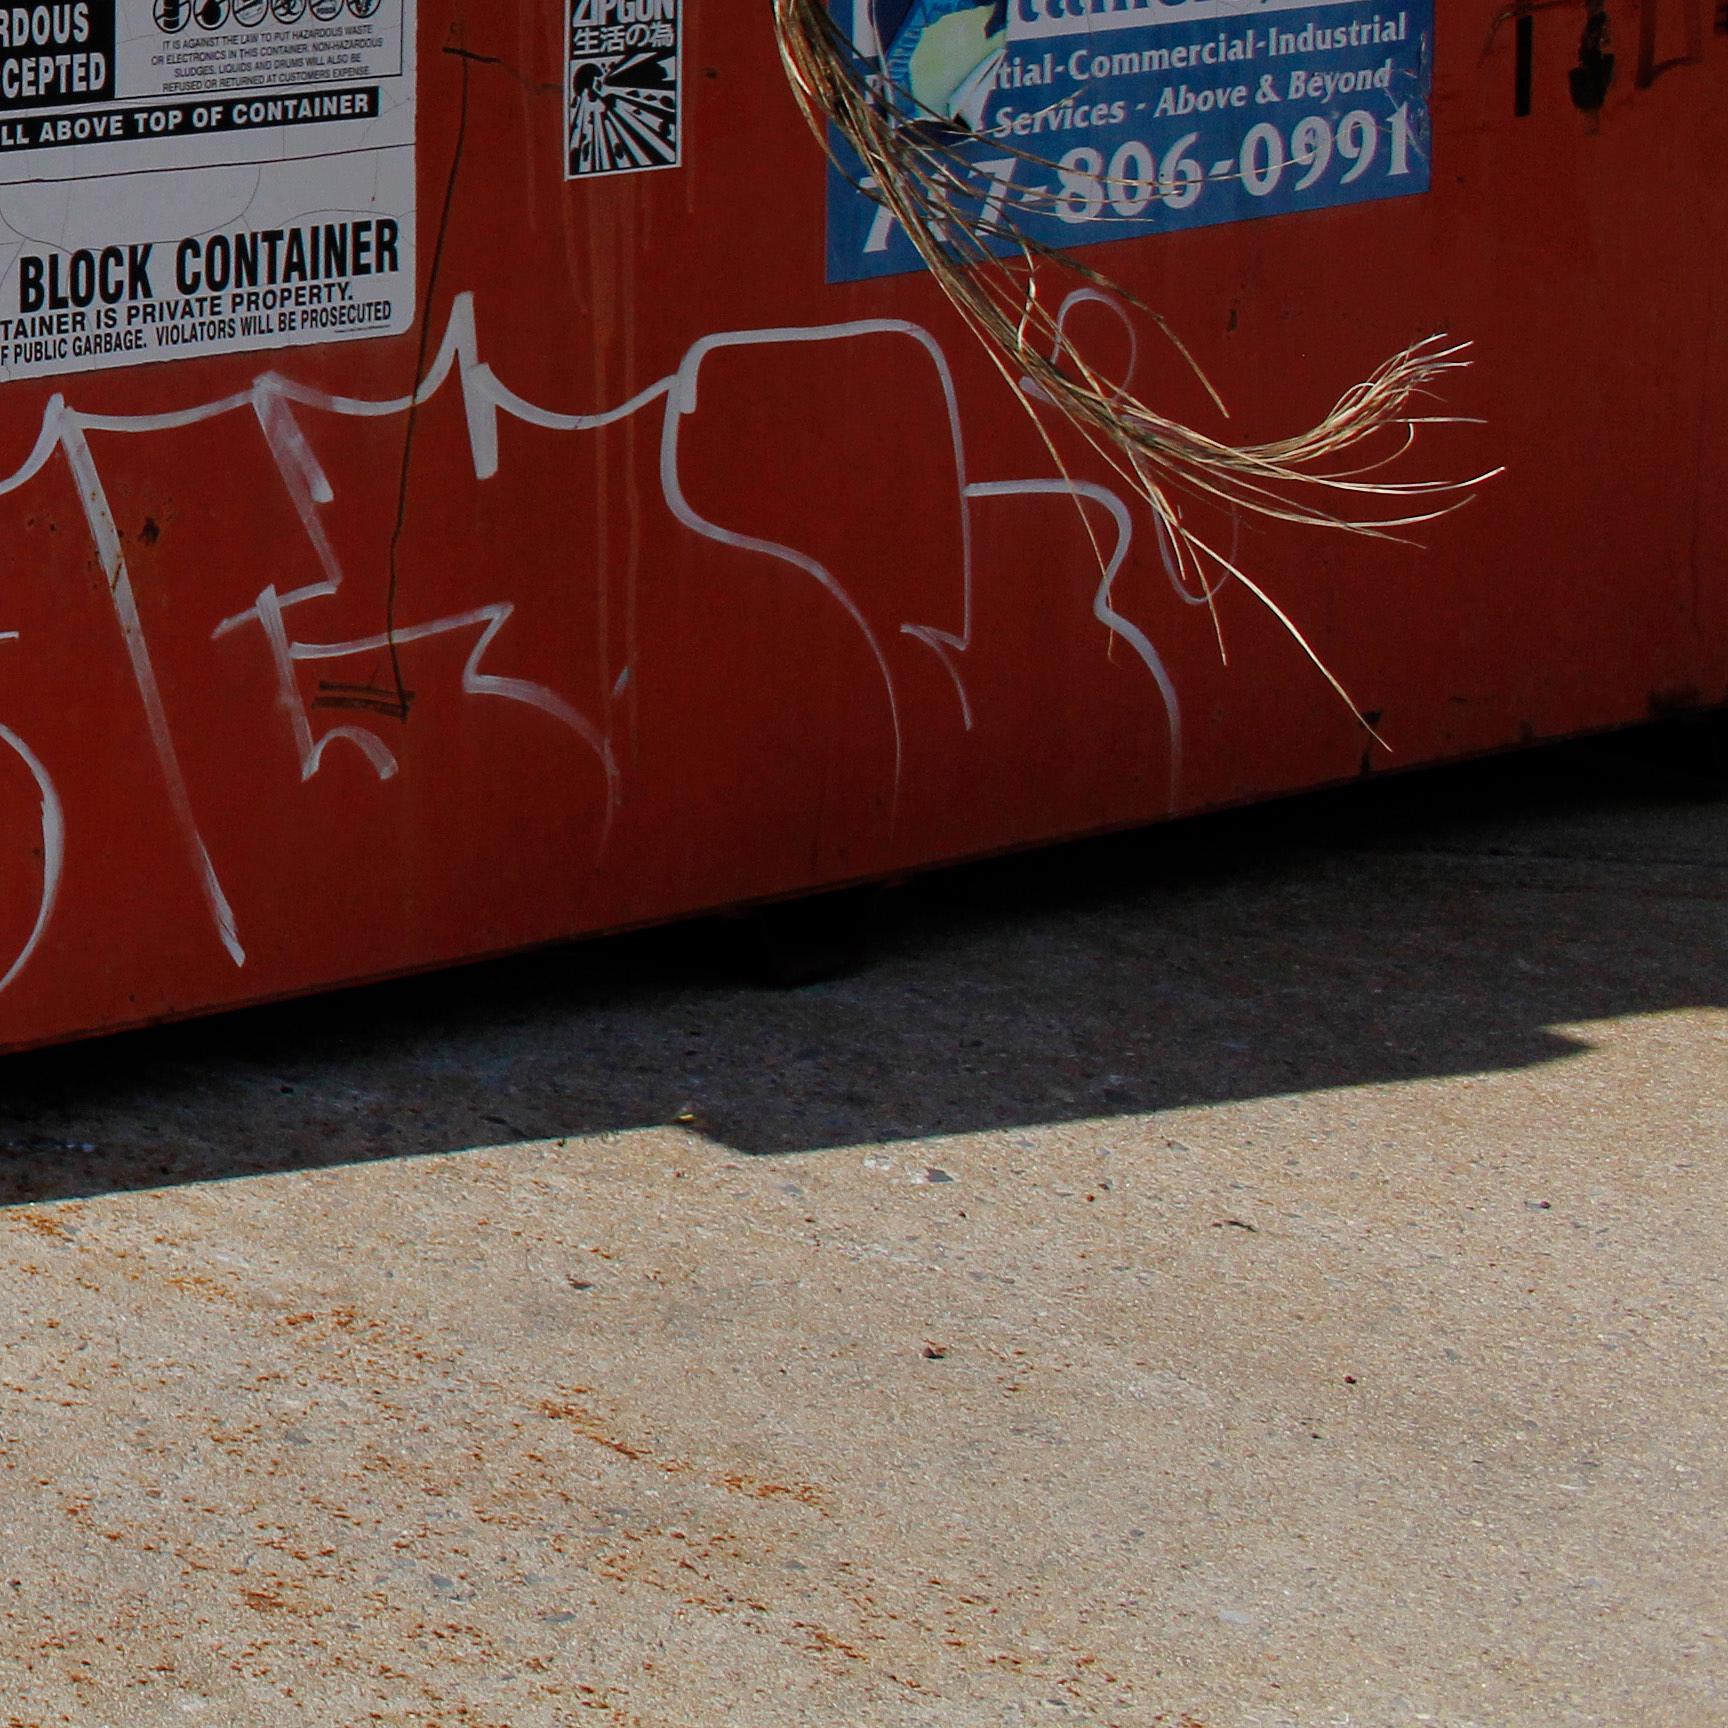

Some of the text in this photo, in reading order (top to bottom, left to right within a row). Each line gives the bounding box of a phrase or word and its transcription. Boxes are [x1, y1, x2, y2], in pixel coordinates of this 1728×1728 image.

[151, 56, 164, 65] OR
[166, 51, 226, 64] ELECTRONICS
[228, 50, 237, 59] IN
[240, 48, 258, 58] THIS
[312, 37, 384, 52] NON-HAZARDOUS
[163, 24, 373, 50] IT IS AGAINST THE LAW TO PUT HAZARDOUS WASTE
[573, 21, 674, 55] 生活の為
[162, 80, 202, 92] REFUSED
[205, 79, 217, 89] OR
[219, 75, 264, 87] RETURNED
[266, 74, 277, 83] AT
[278, 69, 331, 82] CUSTOMERS
[219, 63, 252, 74] LIQUIDS
[254, 60, 272, 70] AND
[274, 58, 304, 70] DRUMS
[305, 56, 325, 66] WILL
[327, 54, 349, 65] ALSO
[350, 52, 361, 63] BE
[39, 114, 124, 143] ABOVE
[134, 110, 183, 134] TOP
[193, 106, 223, 127] OF
[232, 93, 369, 124] CONTAINER
[993, 100, 1125, 138] Services
[1153, 84, 1248, 118] Above
[1255, 74, 1282, 103] &
[1287, 58, 1394, 104] Beyond
[857, 102, 1411, 253] 717-806-0991
[19, 242, 152, 313] BLOCK
[175, 218, 399, 295] CONTAINER
[96, 307, 117, 329] IS
[127, 295, 222, 326] PRIVATE
[231, 281, 353, 314] PROPERTY.
[14, 339, 68, 365] PUBLIC
[72, 329, 146, 357] GARBAGE.
[156, 319, 236, 347] VIOLATORS
[240, 314, 274, 337] WILL
[278, 311, 295, 332] BE
[300, 300, 391, 330] PROSECUTED
